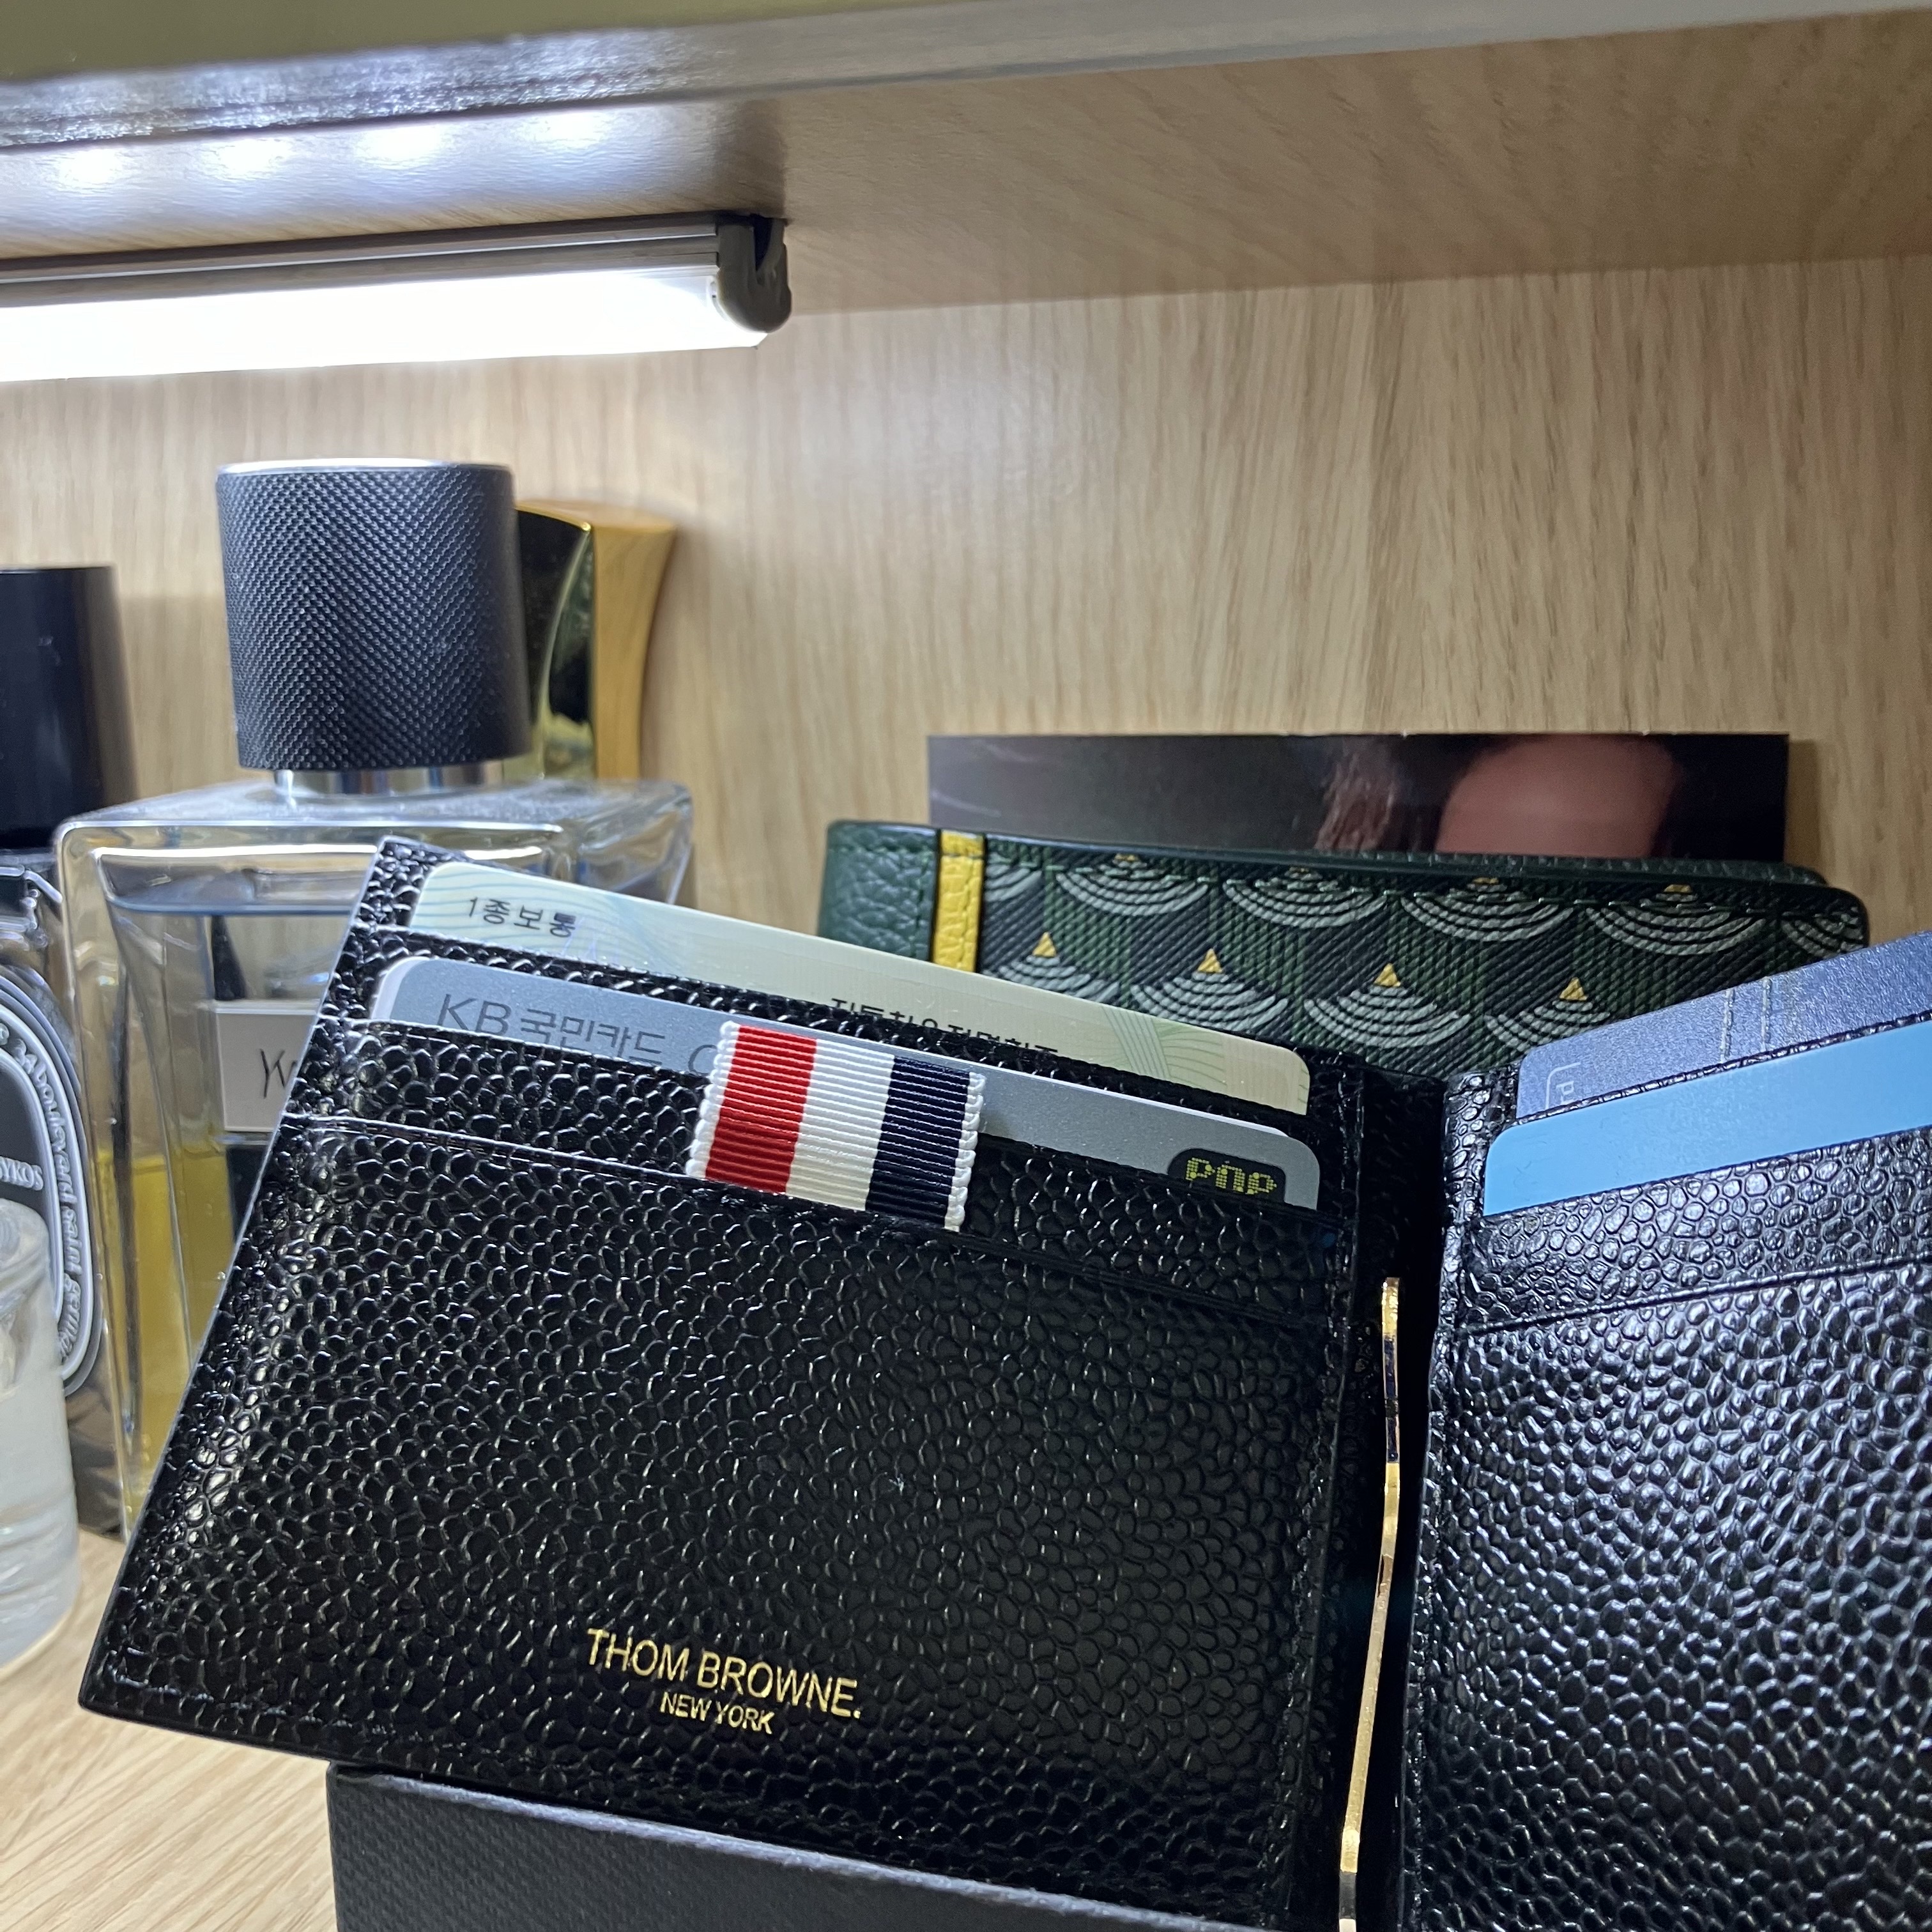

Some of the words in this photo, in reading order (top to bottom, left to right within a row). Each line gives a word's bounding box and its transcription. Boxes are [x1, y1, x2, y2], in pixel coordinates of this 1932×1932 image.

[0, 1156, 44, 1192] YKOS
[586, 1627, 690, 1682] THOM
[696, 1651, 861, 1719] BROWNE.
[659, 1691, 712, 1722] NEW
[716, 1703, 776, 1735] YORK
